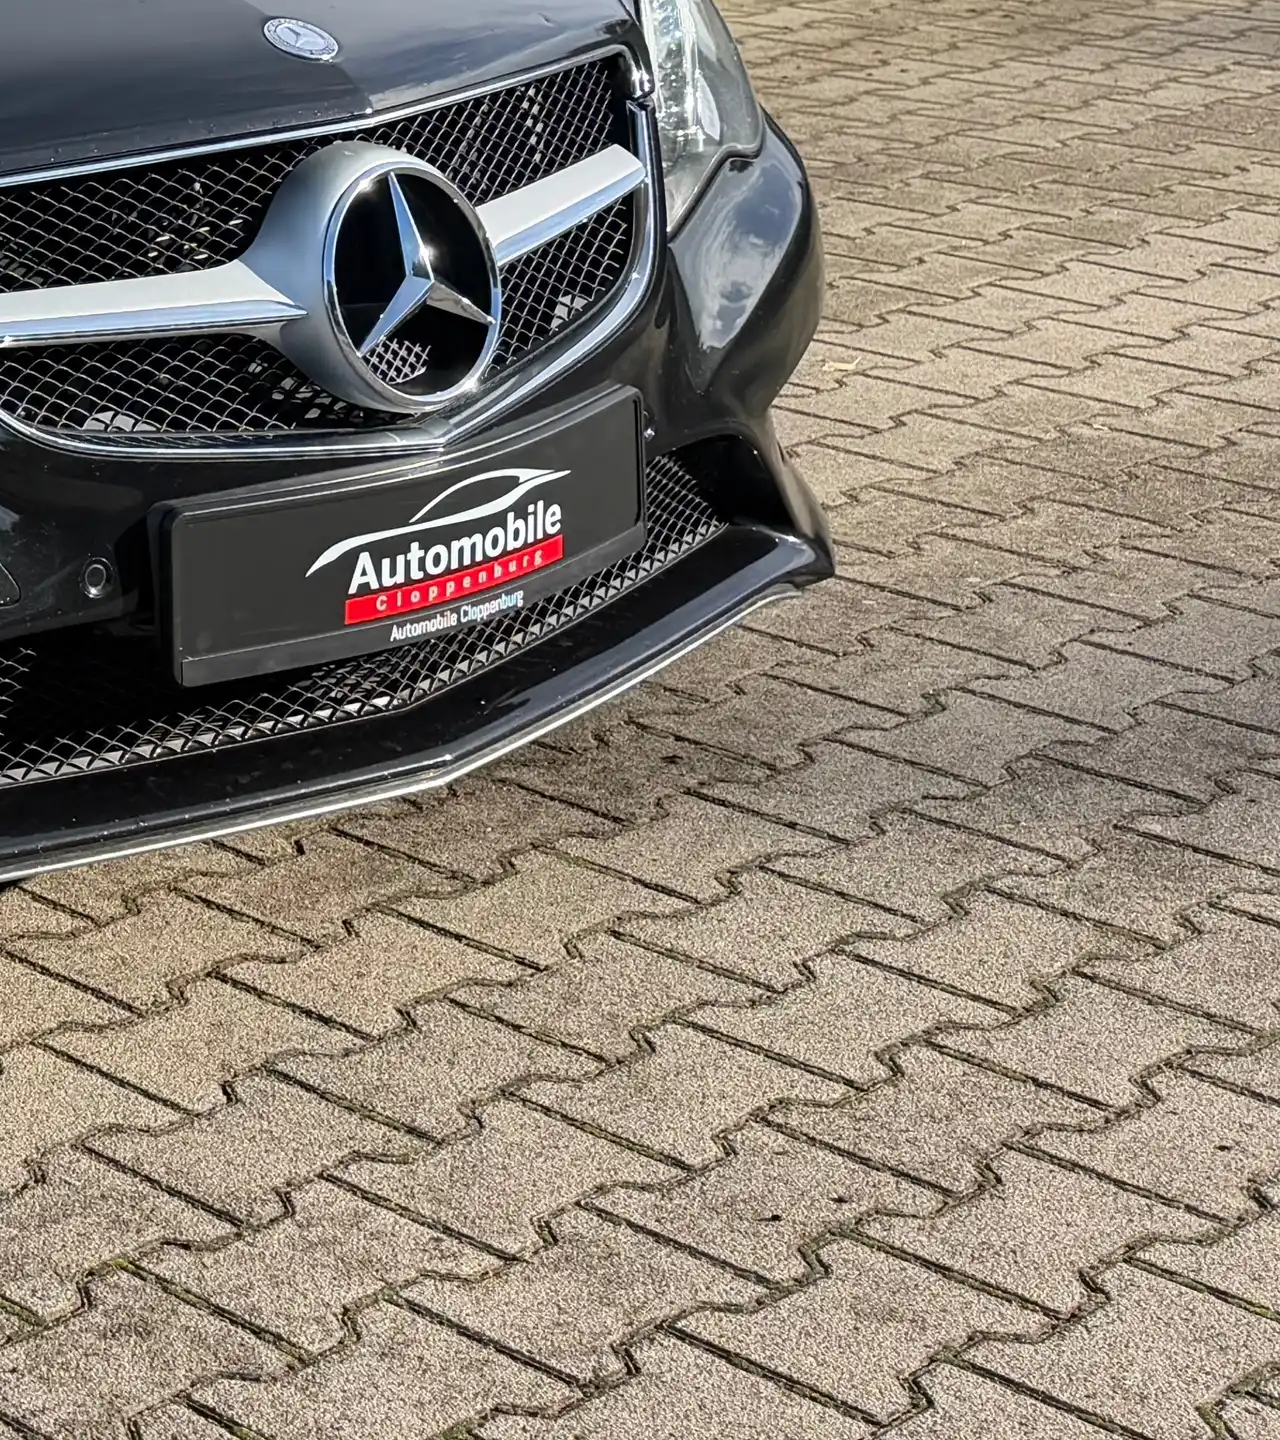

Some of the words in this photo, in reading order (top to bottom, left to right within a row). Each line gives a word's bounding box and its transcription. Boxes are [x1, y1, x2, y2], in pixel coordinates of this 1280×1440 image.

[348, 501, 562, 594] Automobile
[376, 550, 543, 611] Cloppenburg
[391, 613, 458, 642] Automobile
[460, 590, 524, 623] Cloppenburg
